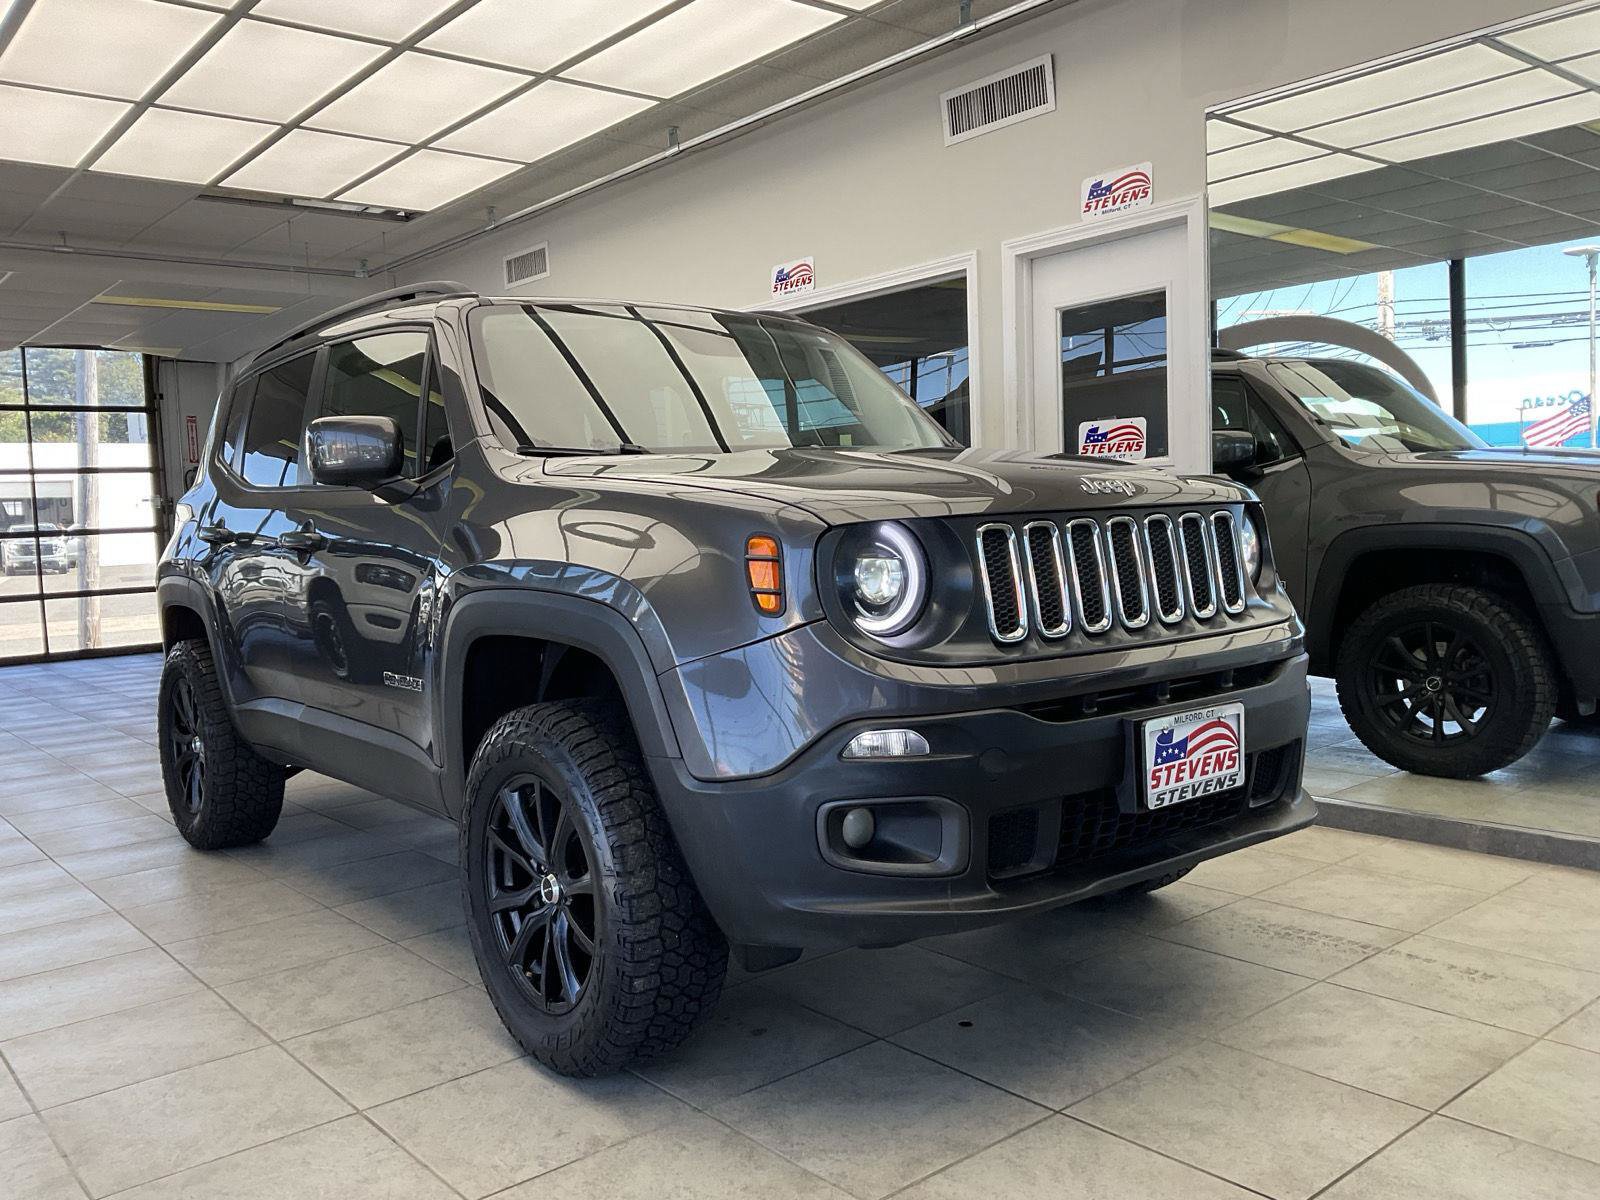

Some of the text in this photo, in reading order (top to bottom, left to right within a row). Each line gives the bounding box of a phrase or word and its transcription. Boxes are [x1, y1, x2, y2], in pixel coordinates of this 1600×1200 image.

[1083, 186, 1151, 213] STEVENS
[772, 275, 813, 293] STEVENS
[1081, 441, 1144, 455] STEVENS
[1080, 477, 1136, 497] Jeep
[1205, 709, 1215, 718] CT
[1151, 747, 1239, 790] STEVENS
[1154, 773, 1239, 808] STEVENS
